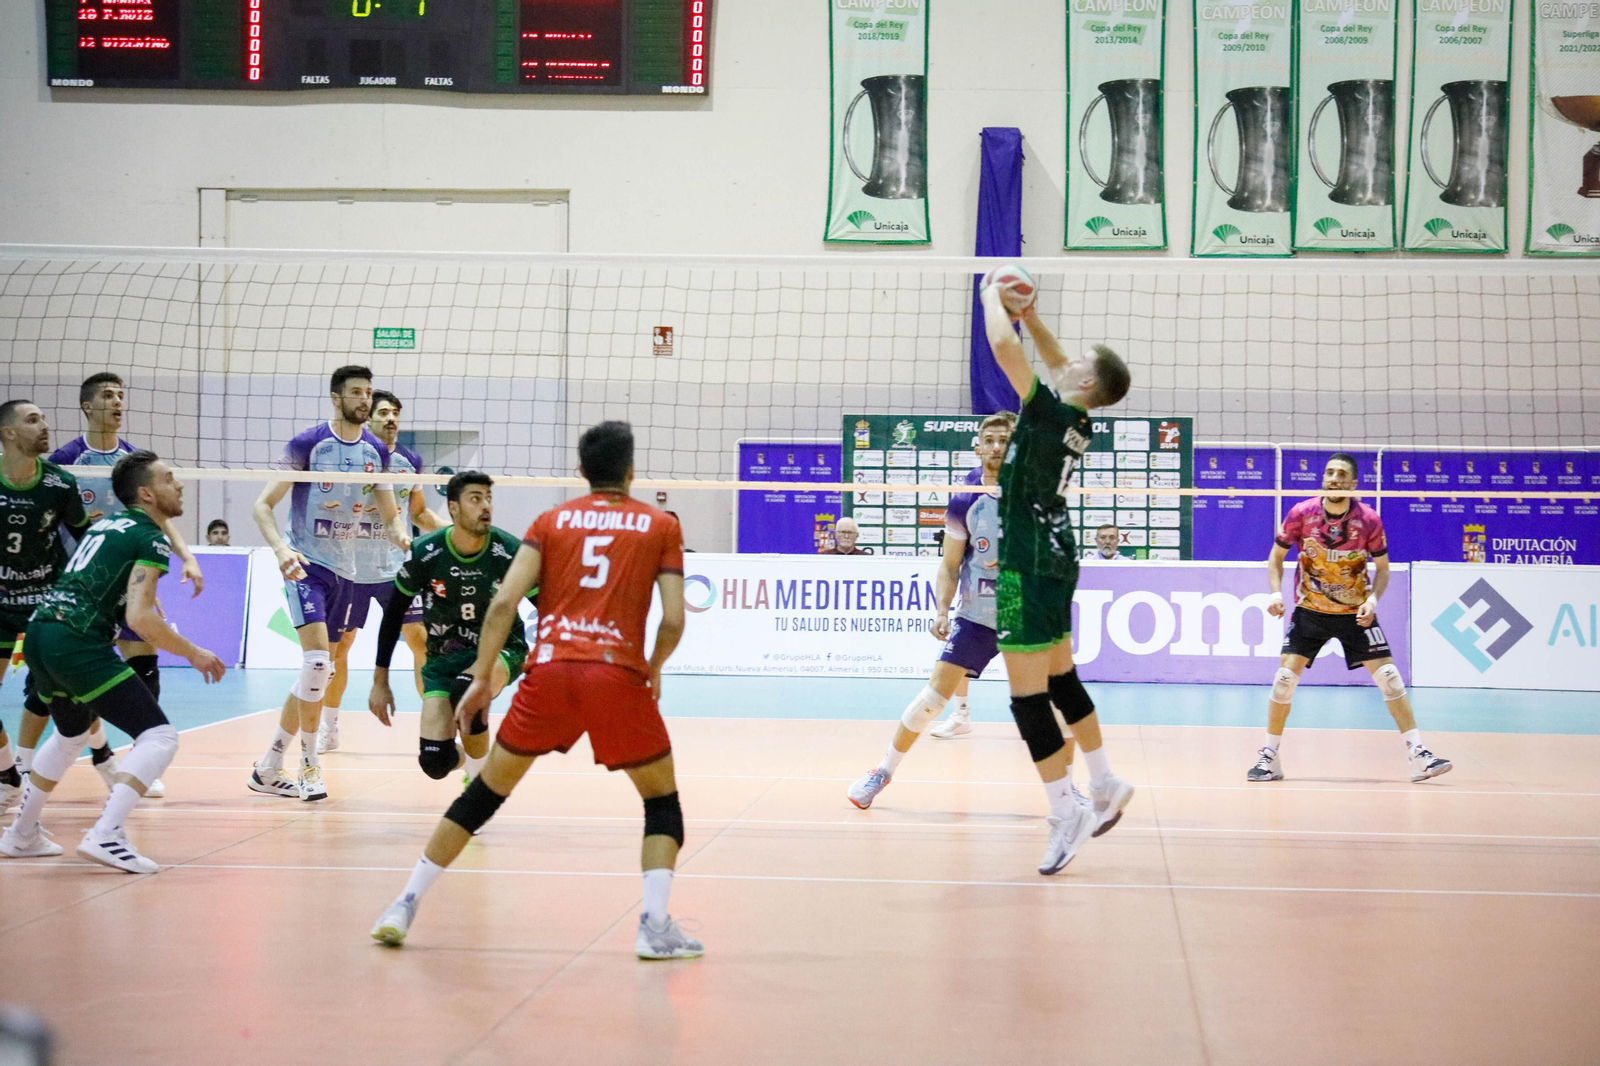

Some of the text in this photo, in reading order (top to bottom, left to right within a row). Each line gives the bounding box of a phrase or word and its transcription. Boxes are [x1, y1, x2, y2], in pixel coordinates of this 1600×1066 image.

[1202, 4, 1286, 20] CAMPEÓN
[1540, 3, 1600, 19] CAMPE
[853, 20, 904, 30] Copa del Rey
[1090, 24, 1110, 33] Copa
[1127, 24, 1142, 34] Rey
[1320, 24, 1372, 34] Copa del Rey
[1435, 24, 1487, 34] Copa del Rey
[858, 32, 900, 41] 2018/2019
[1218, 32, 1270, 41] Copa del Rey
[1562, 30, 1600, 38] Superliga
[1094, 36, 1138, 44] 2013/2014
[1324, 36, 1368, 44] 2008/2009
[1439, 36, 1482, 45] 2006/2007
[1222, 44, 1266, 52] 2009/2010
[51, 79, 94, 87] MONDO
[301, 76, 330, 84] FALTAS
[359, 76, 397, 85] JUGADOR
[424, 77, 454, 86] FALTAS
[662, 86, 704, 94] MONDO
[874, 220, 909, 231] Unicaja
[1112, 226, 1147, 237] Unicaja
[1340, 228, 1376, 239] Unicaja
[1451, 229, 1486, 240] Unicaja
[1240, 234, 1275, 246] Unicaja
[1573, 234, 1600, 244] Unica
[923, 421, 981, 432] SUPERL
[556, 509, 652, 532] PAQUILLO
[334, 522, 354, 531] Grup
[6, 532, 22, 554] 3
[1492, 536, 1577, 552] DIPUTACIÓN
[64, 534, 106, 573] 10
[580, 536, 614, 588] 5
[0, 564, 52, 580] Unicaja
[722, 573, 938, 612] HLA MEDITERRÁN
[0, 594, 46, 606] ALMER
[460, 603, 476, 620] 8
[775, 617, 934, 634] TU SALUD ES NUESTRA PRIO
[1364, 626, 1386, 646] 10
